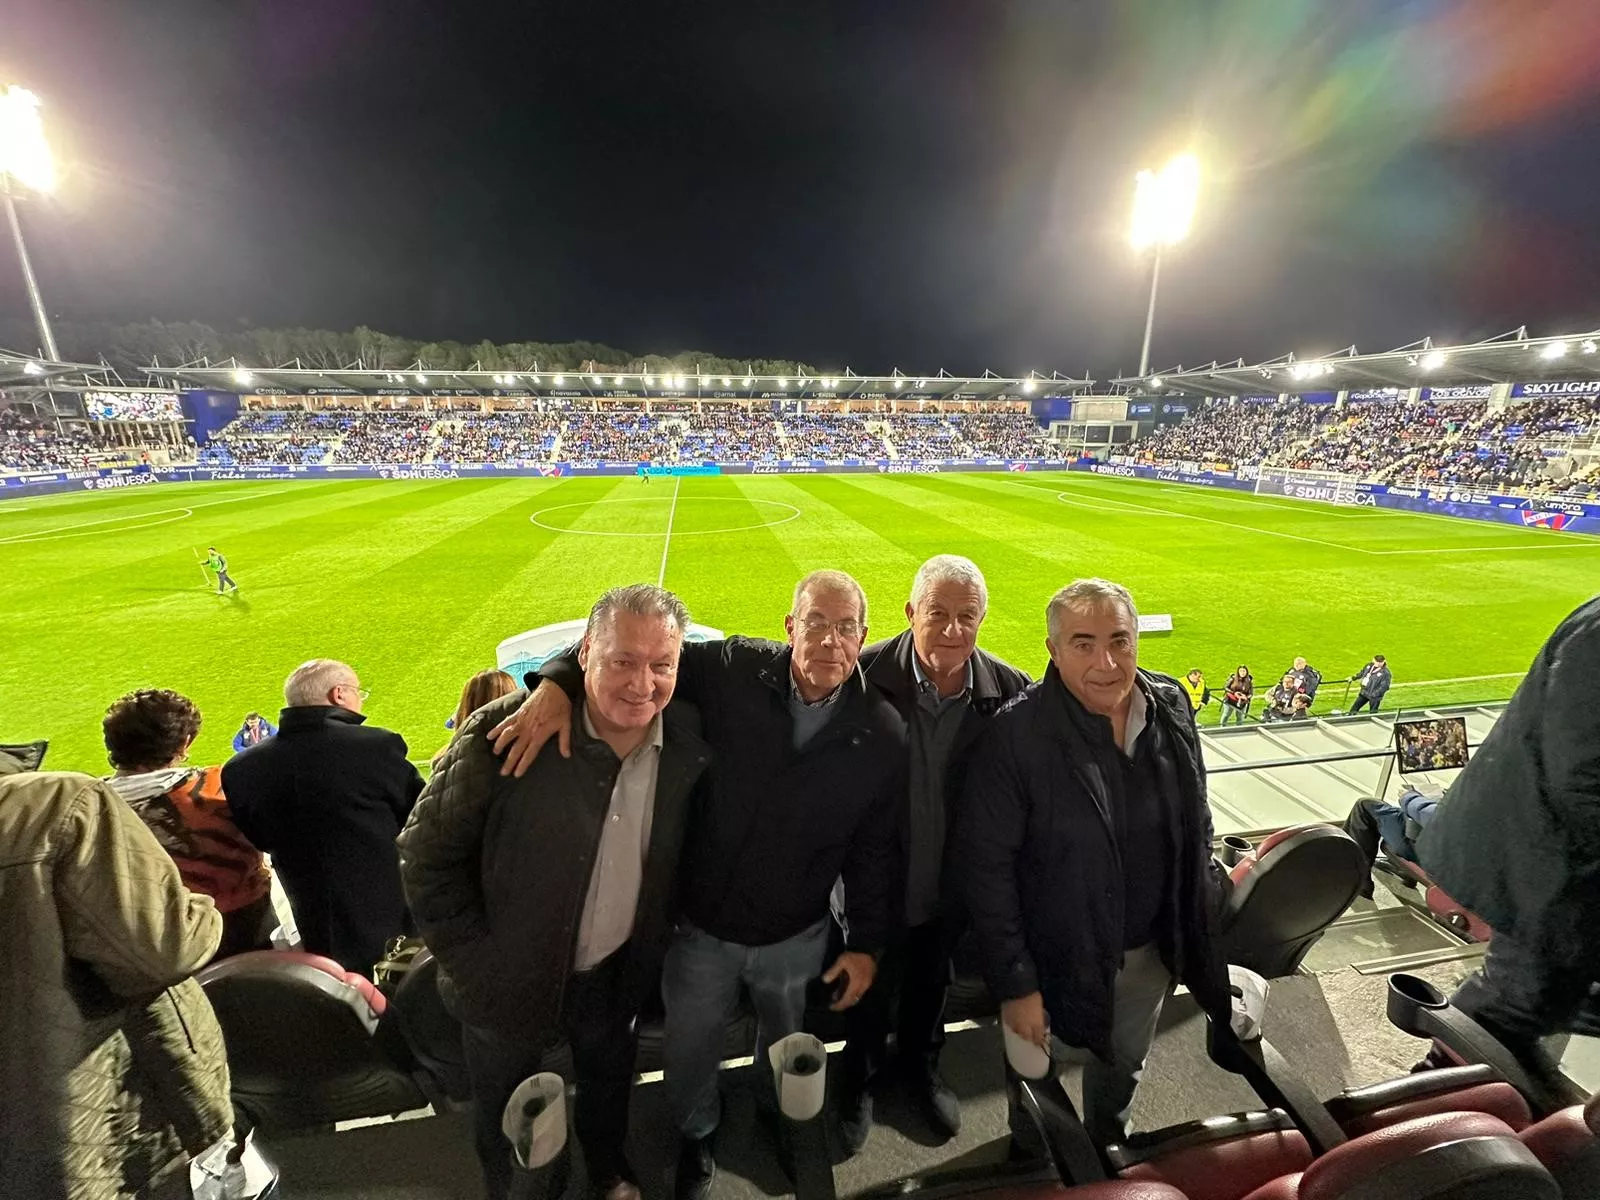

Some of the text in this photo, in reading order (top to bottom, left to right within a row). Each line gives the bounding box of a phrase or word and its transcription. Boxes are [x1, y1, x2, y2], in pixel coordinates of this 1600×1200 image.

[392, 469, 459, 479] SDHUESCA
[888, 465, 940, 473] SDHUESCA
[1097, 465, 1136, 477] SDHUESCA
[96, 473, 160, 489] SDHUESCA
[1295, 487, 1377, 507] SDHUESCA
